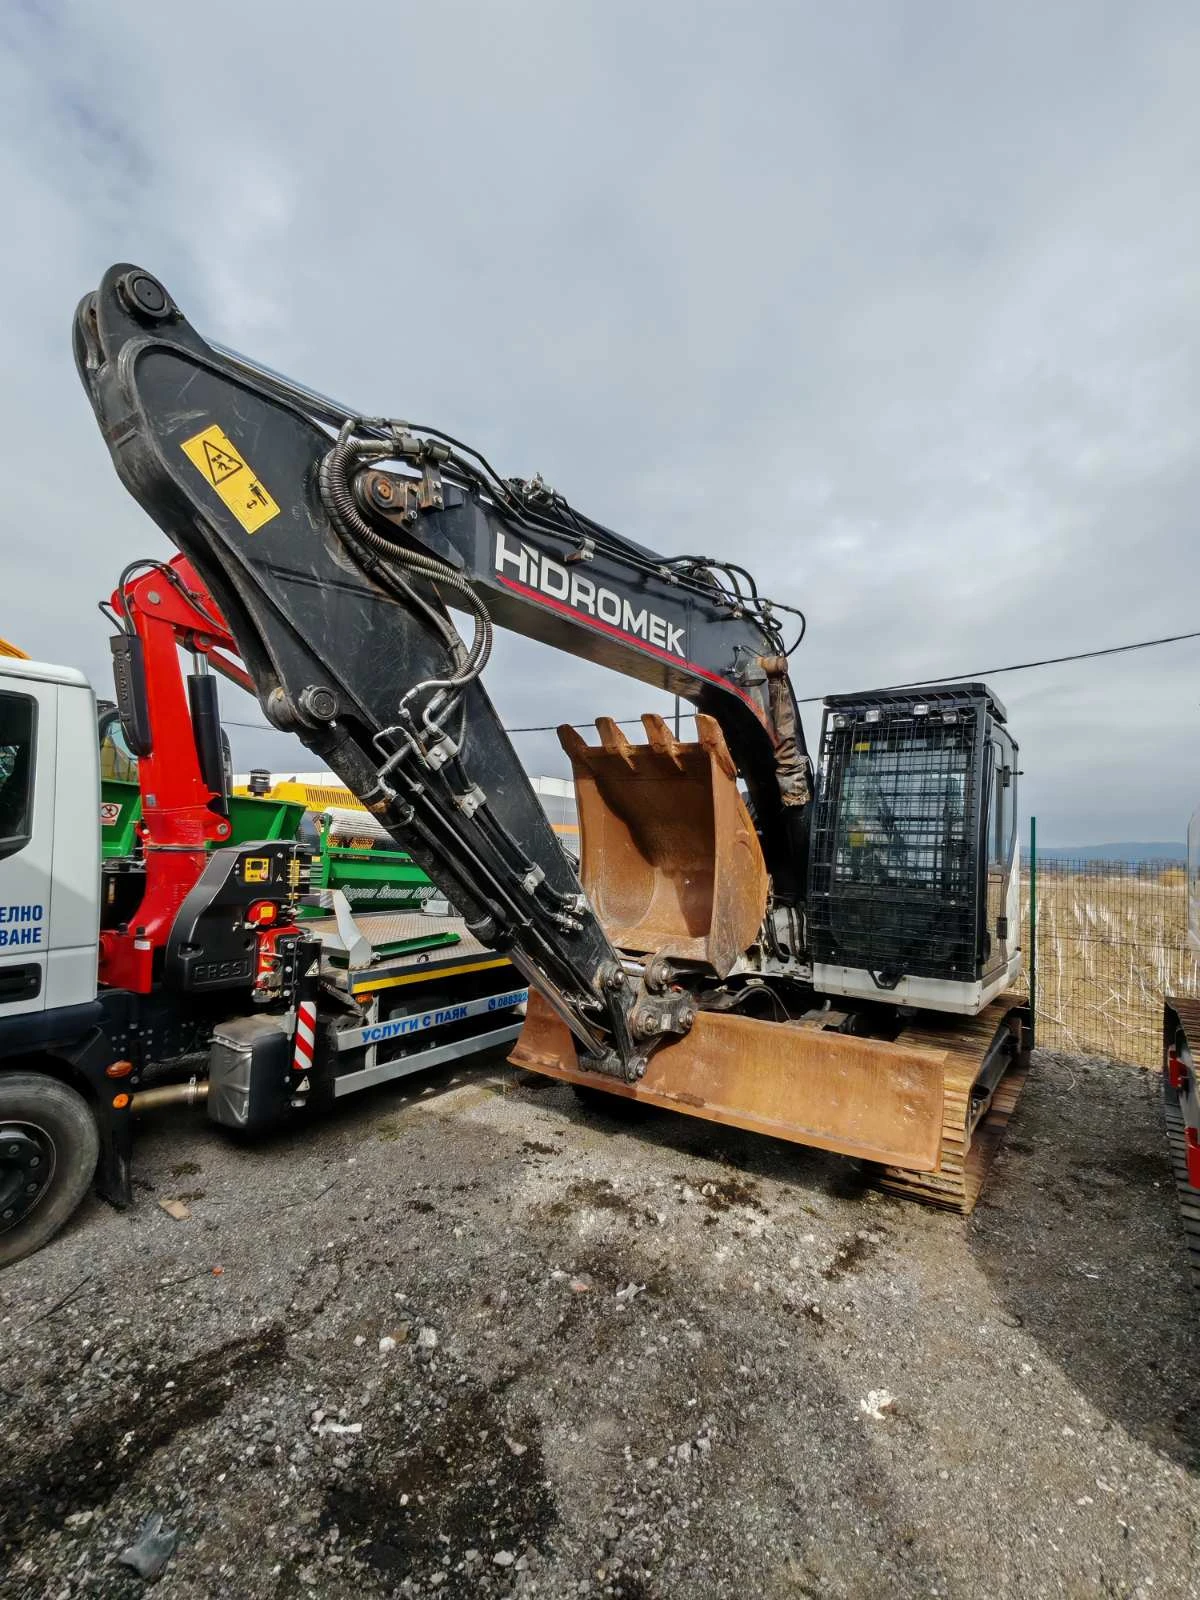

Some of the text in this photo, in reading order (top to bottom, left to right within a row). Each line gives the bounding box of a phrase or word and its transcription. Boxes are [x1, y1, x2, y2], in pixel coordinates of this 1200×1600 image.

[0, 905, 43, 923] ЕЛНО
[0, 927, 42, 947] ВАНЕ
[361, 990, 529, 1043] УСЛУГИ С ПАЯК 088322
